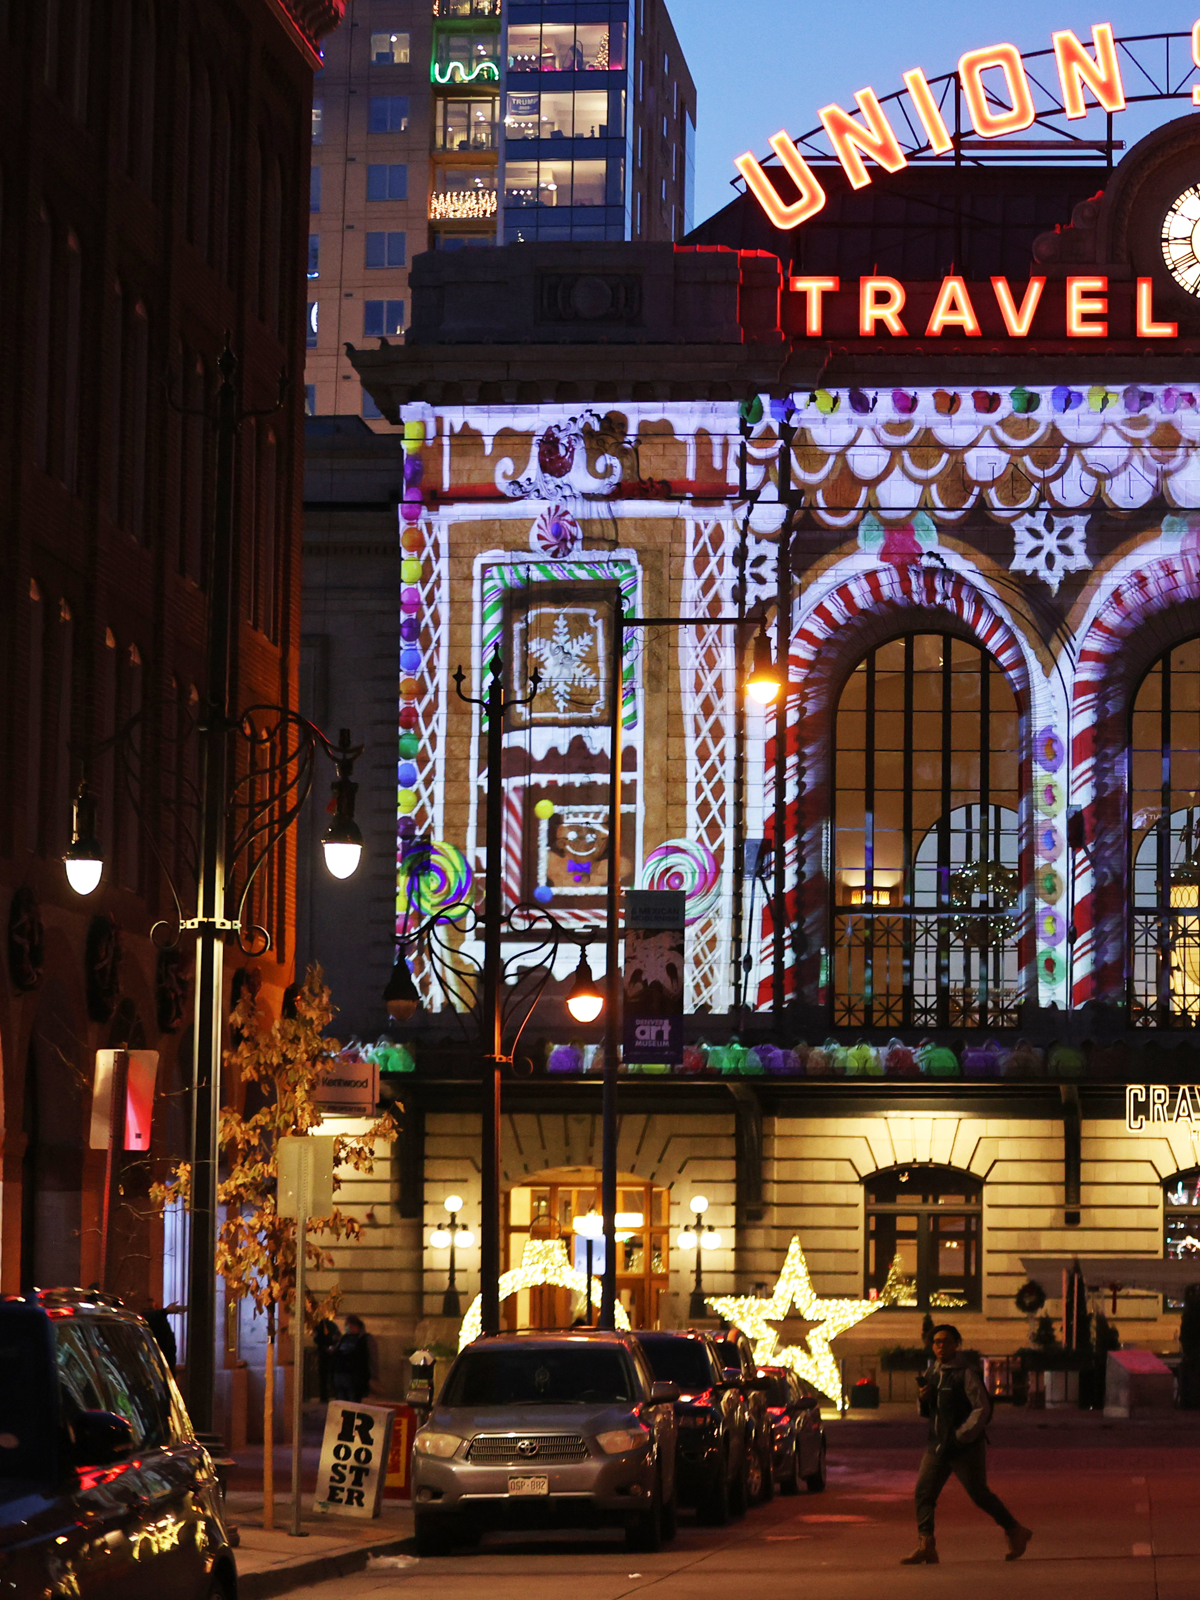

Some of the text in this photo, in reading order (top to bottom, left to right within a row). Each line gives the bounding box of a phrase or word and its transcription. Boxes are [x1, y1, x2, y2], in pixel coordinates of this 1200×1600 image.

[733, 22, 1127, 231] UNION
[789, 276, 1178, 338] TRAVEL
[955, 462, 1166, 500] UNION
[634, 1019, 672, 1040] art
[322, 1077, 369, 1089] Kentwood
